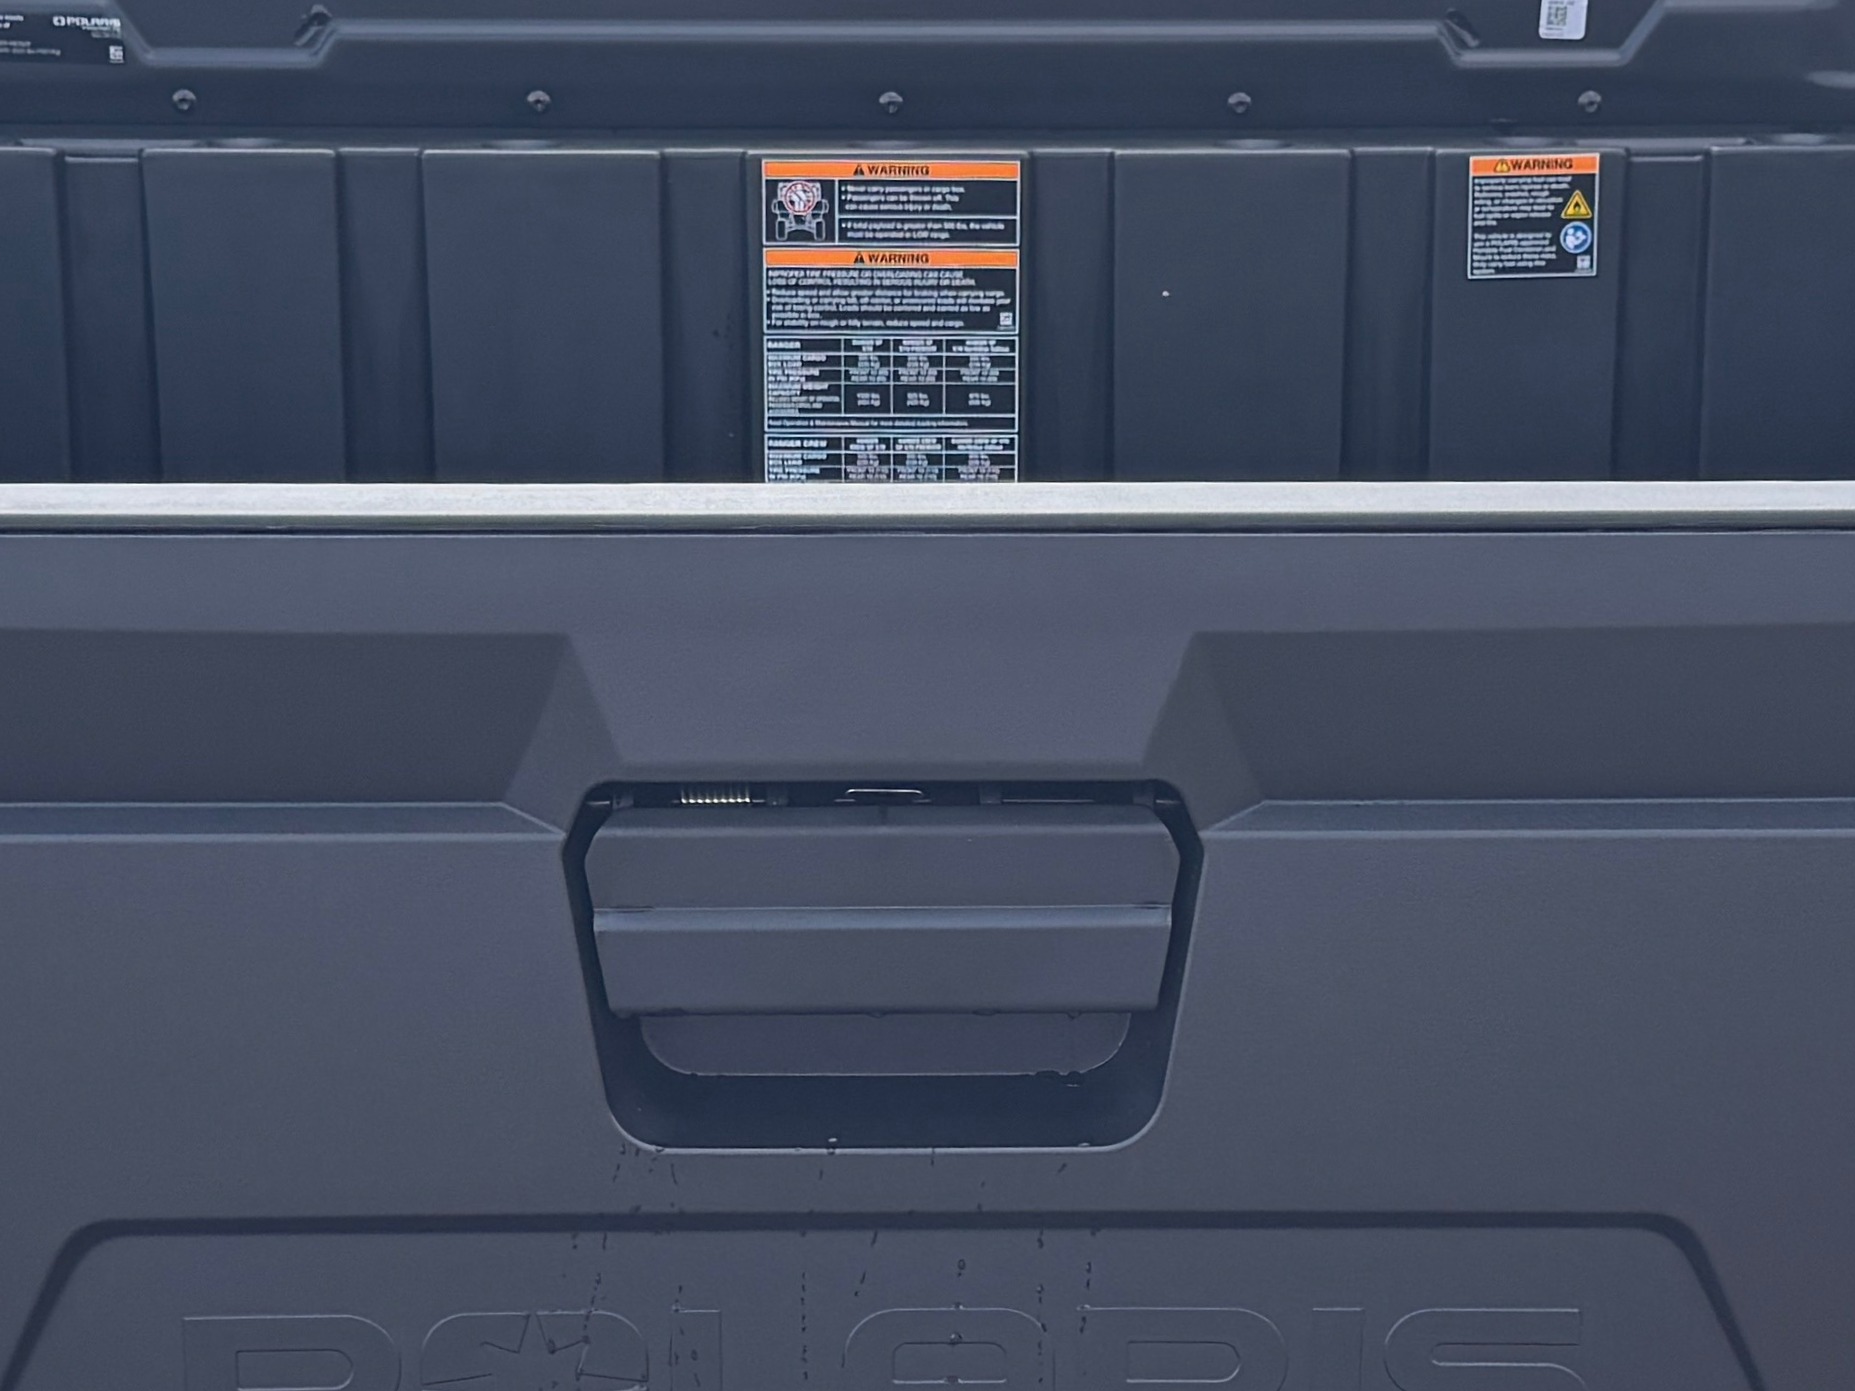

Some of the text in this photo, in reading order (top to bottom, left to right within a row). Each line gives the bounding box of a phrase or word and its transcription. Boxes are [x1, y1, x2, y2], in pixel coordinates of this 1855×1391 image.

[66, 17, 121, 28] POLARIS
[1510, 158, 1573, 170] WARNING
[867, 165, 930, 176] WARNING
[868, 254, 930, 264] WARNING
